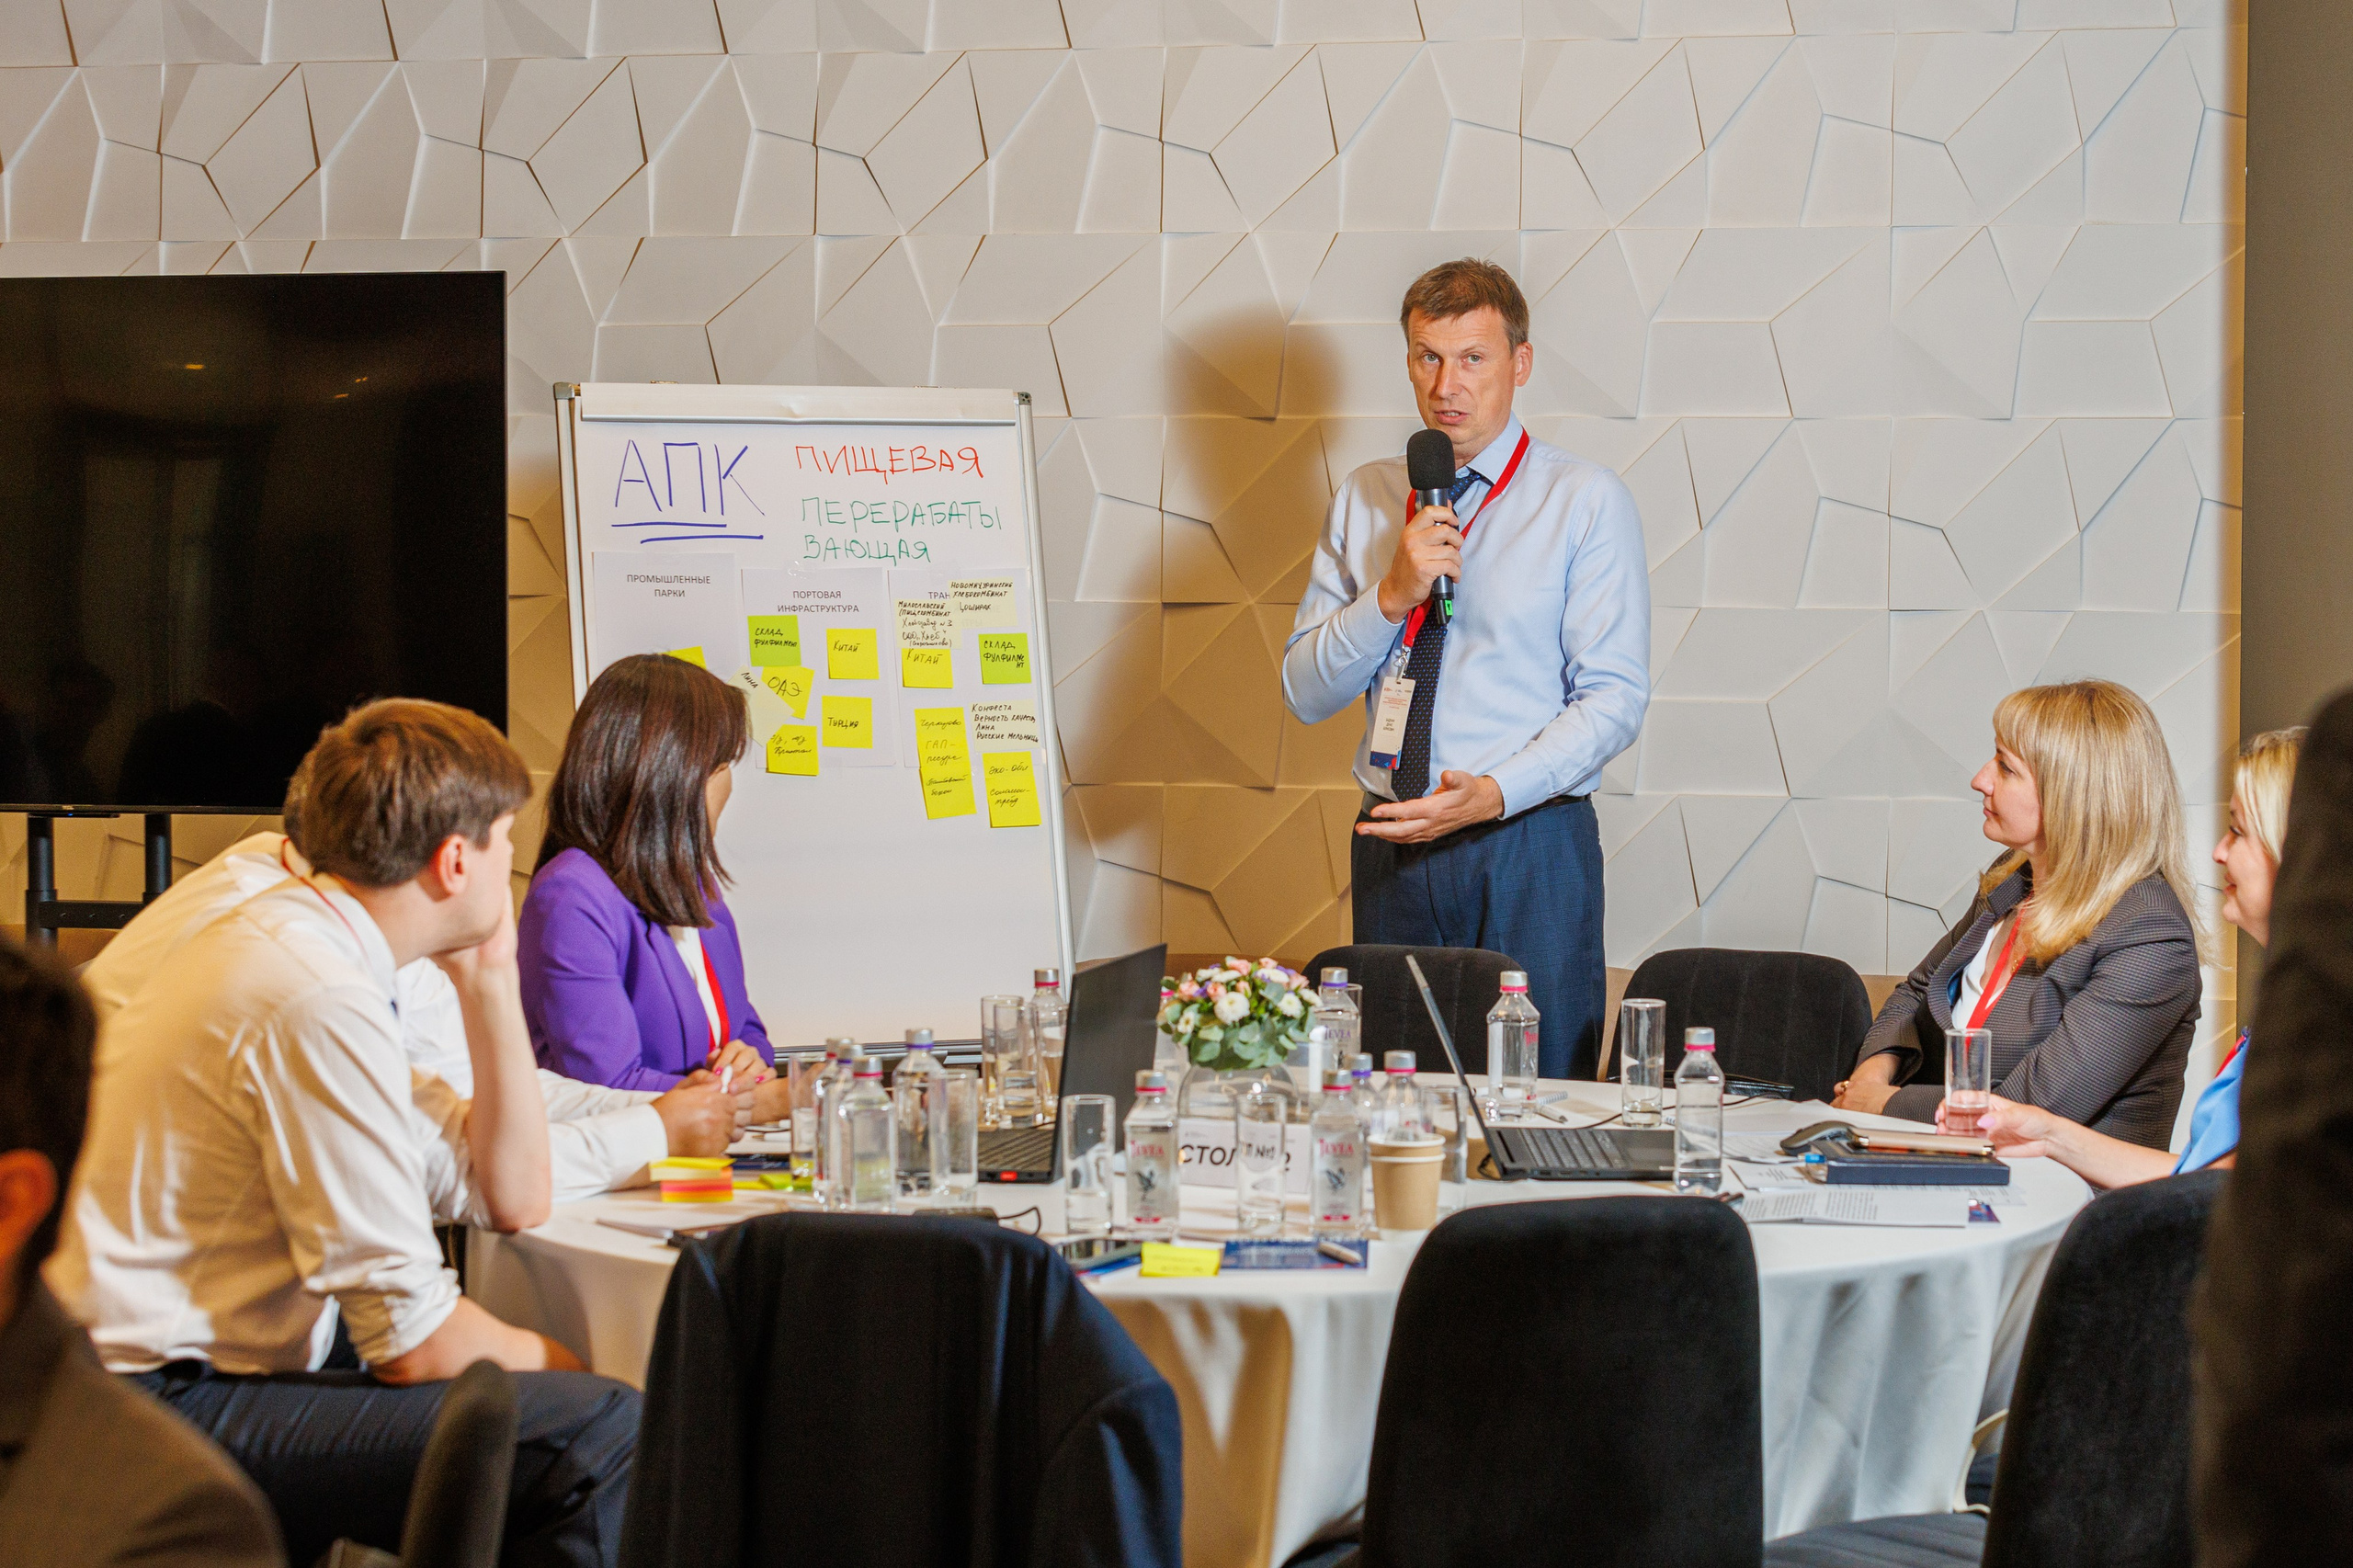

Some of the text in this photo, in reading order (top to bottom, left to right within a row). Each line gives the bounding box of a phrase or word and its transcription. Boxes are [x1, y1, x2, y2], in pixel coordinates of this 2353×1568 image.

[795, 445, 983, 485] ПИЩЕВАЯ
[615, 439, 766, 517] АПК
[801, 497, 1002, 533] ПЕРЕРАБАТЫ
[803, 535, 931, 567] ВАЮЩАЯ
[627, 574, 710, 585] ПРОМЫШЛЕННЫЕ
[654, 589, 686, 598] ПАРКИ
[792, 591, 842, 599] ПОРТОВАЯ
[778, 605, 859, 613] ИНФРАСТРУКТУРА
[755, 628, 783, 636] СКЛАД
[983, 641, 1016, 652] СКЛАД
[767, 676, 802, 697] ОАЭ
